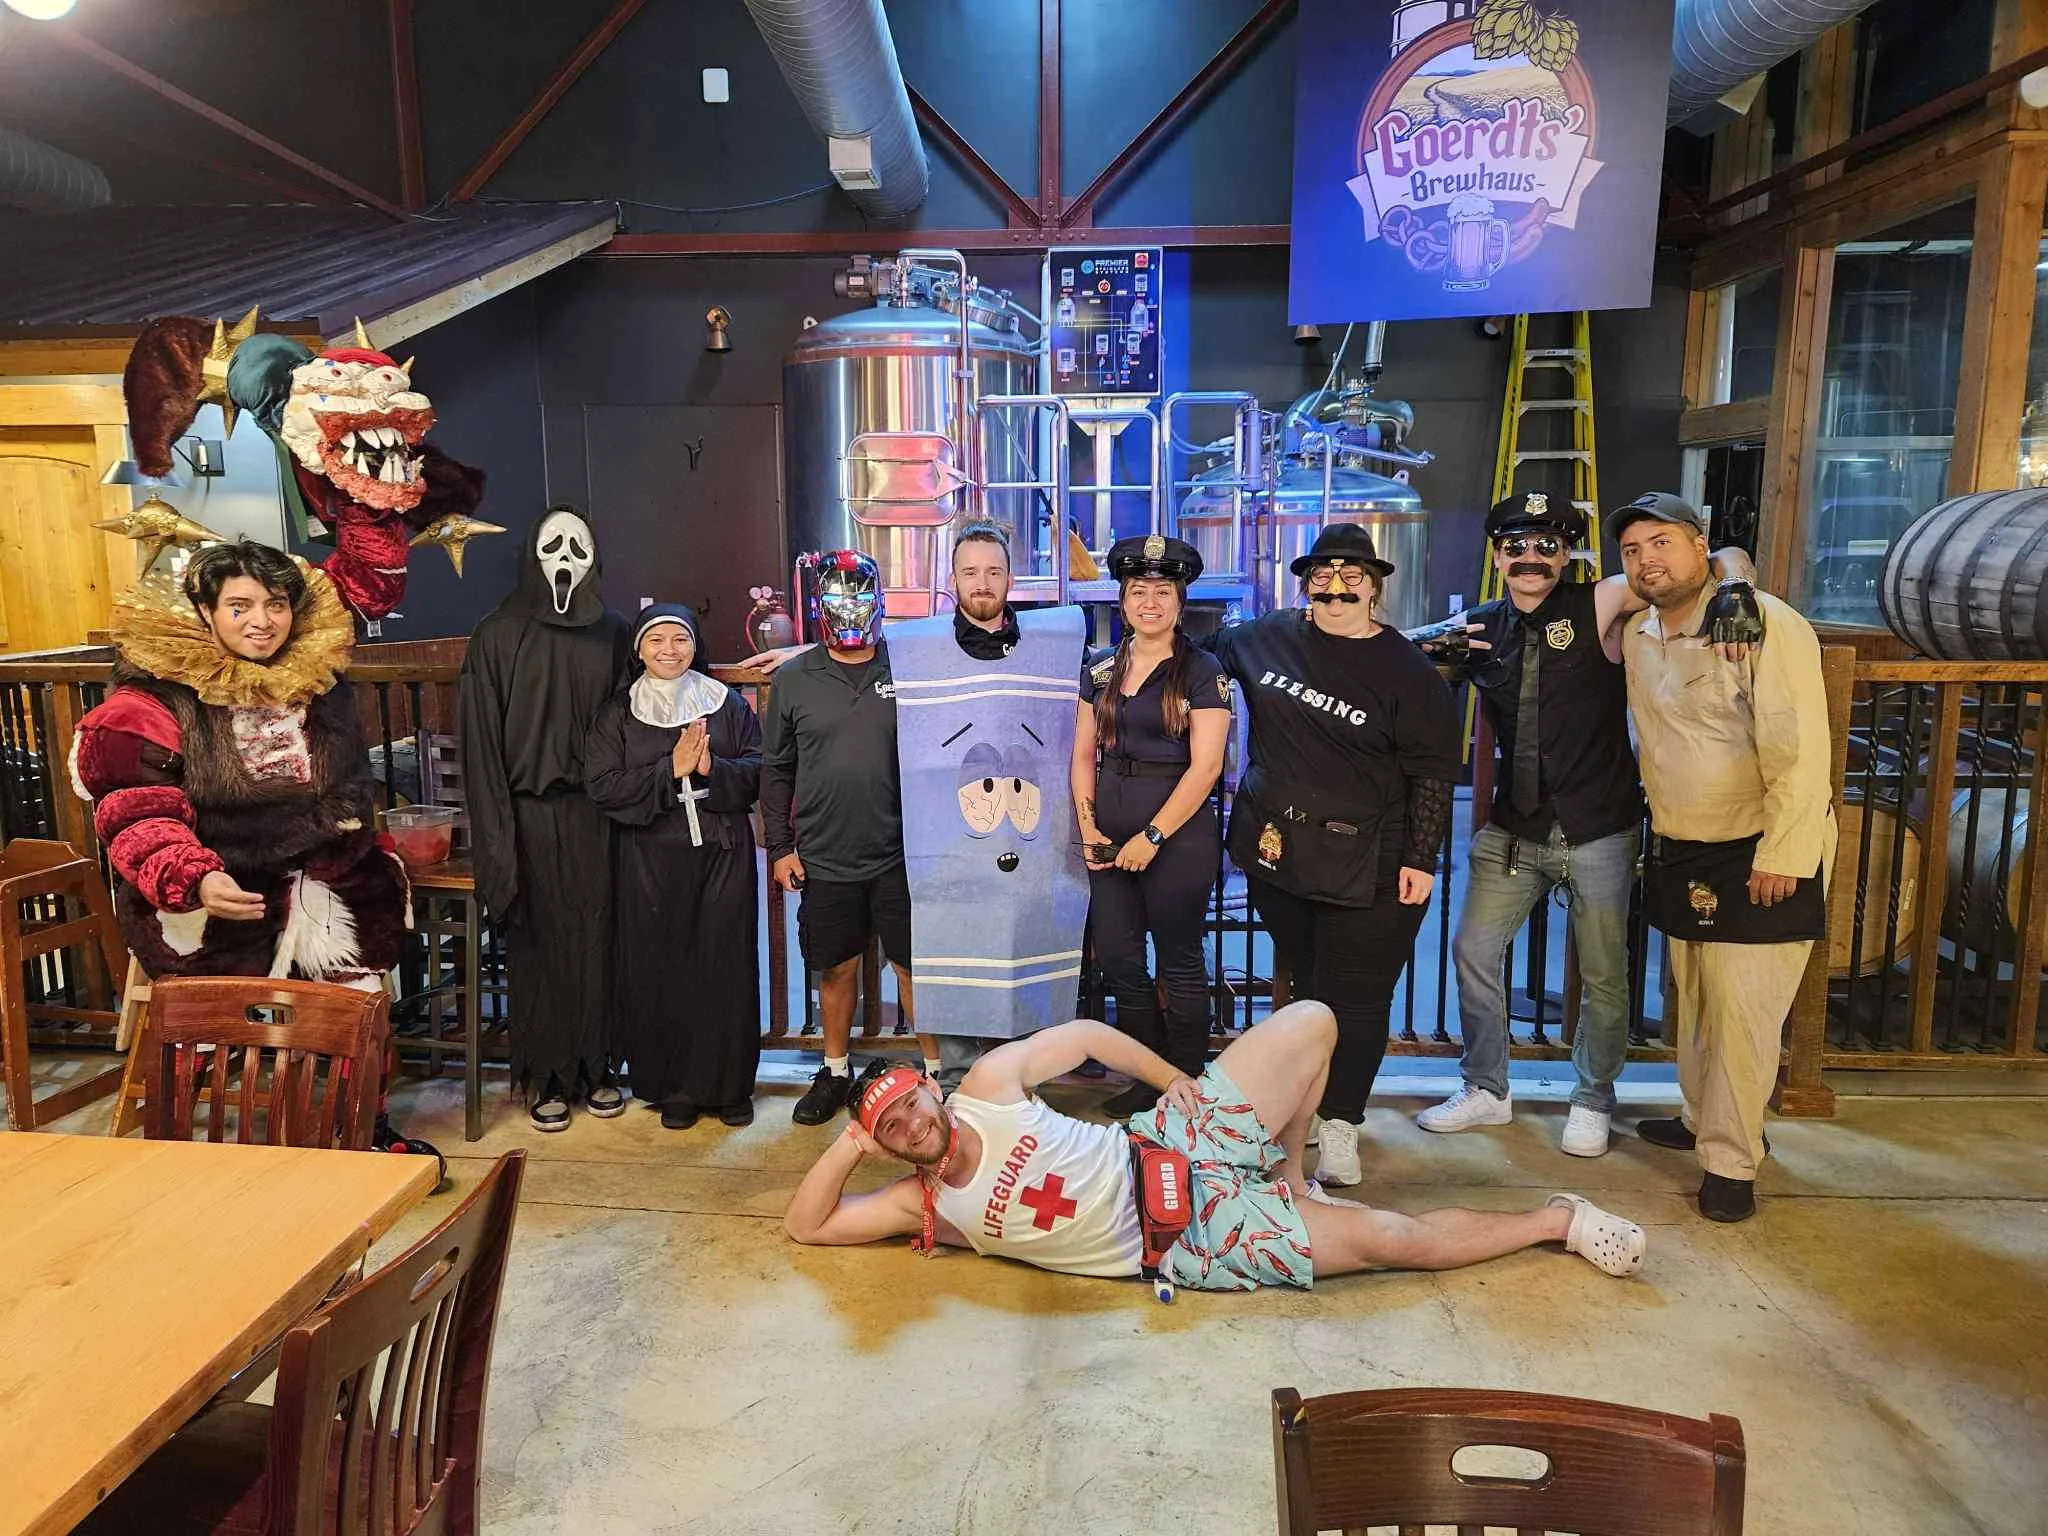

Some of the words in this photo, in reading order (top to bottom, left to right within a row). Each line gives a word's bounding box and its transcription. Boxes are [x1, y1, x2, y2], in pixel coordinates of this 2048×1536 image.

[1376, 101, 1583, 177] Goerdts'
[1260, 671, 1367, 726] BLESSING
[864, 1076, 896, 1111] GUARD
[983, 1135, 1039, 1240] LIFEGUARD
[1160, 1163, 1179, 1210] GUARD
